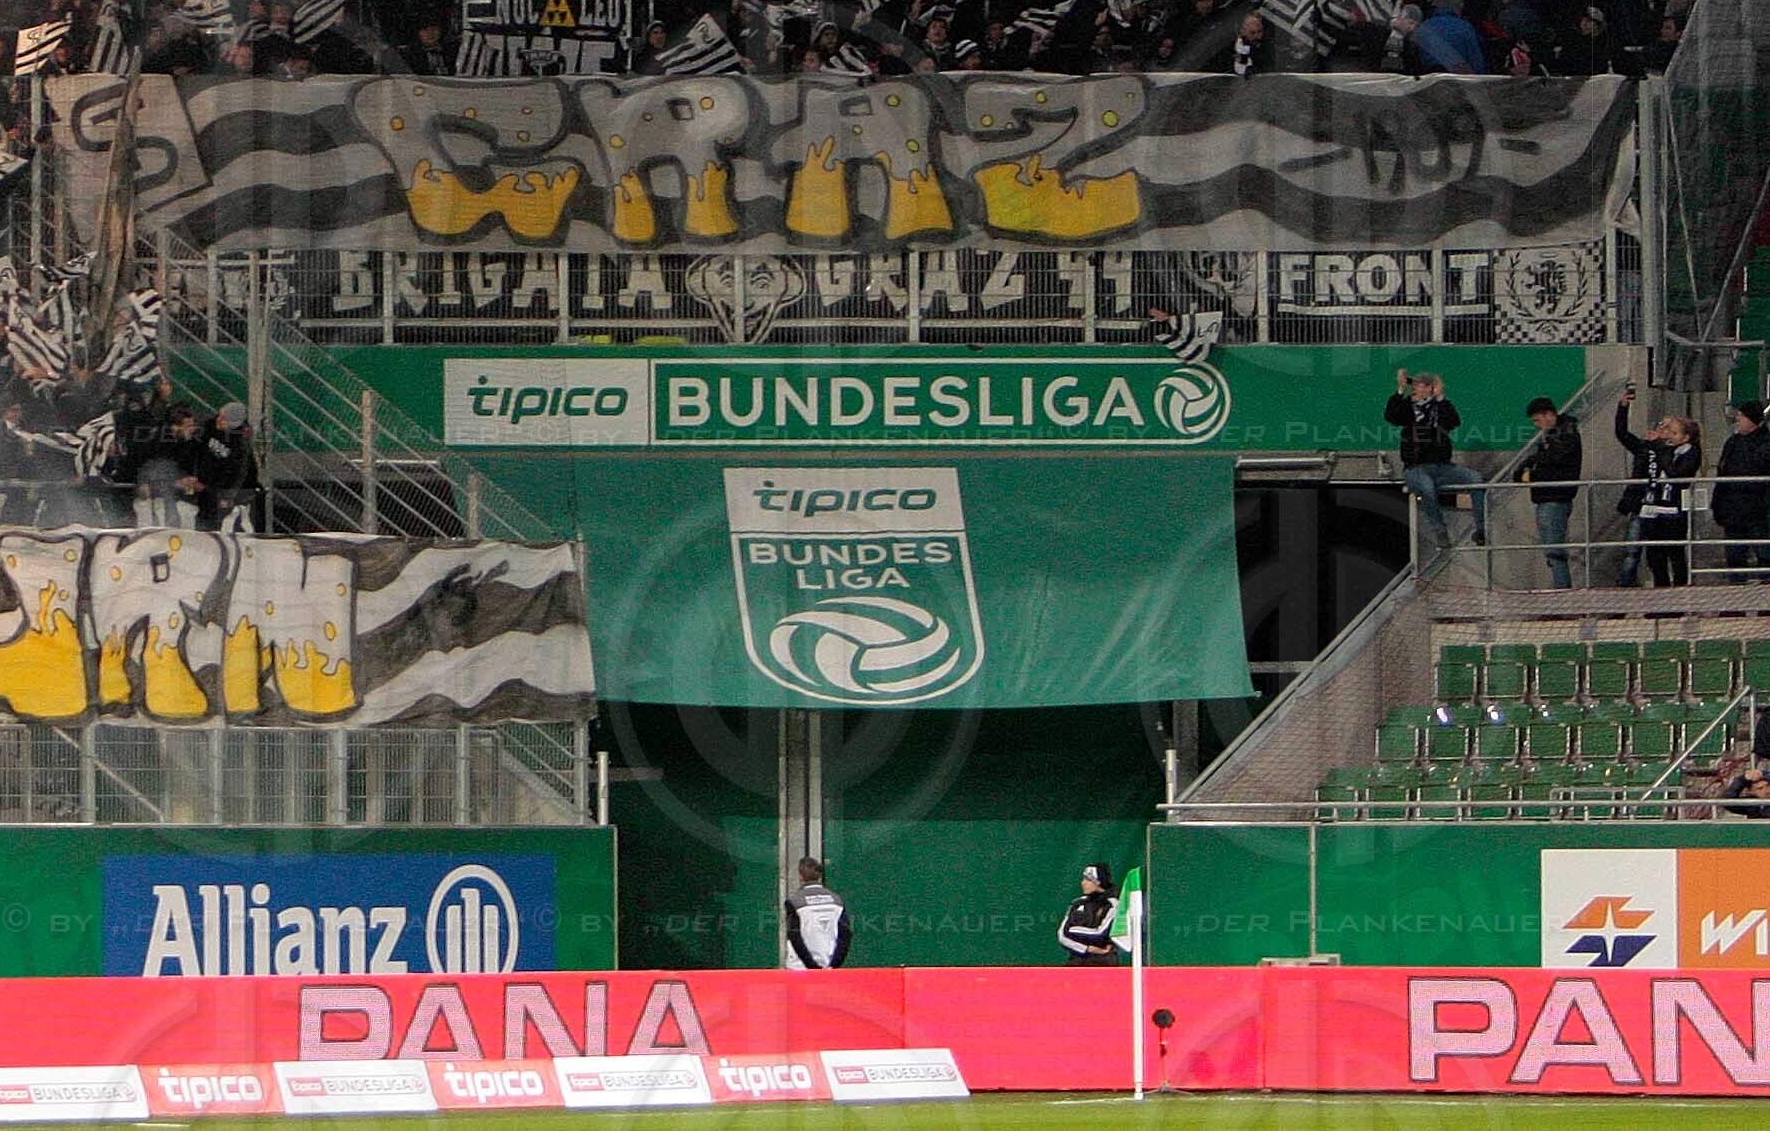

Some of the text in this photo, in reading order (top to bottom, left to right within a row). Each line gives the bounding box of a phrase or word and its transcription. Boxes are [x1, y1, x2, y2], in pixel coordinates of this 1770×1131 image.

[1279, 253, 1490, 303] FRONT
[466, 375, 1145, 427] tipico BUNDESLIGA
[752, 480, 937, 518] tipico
[748, 542, 953, 566] BUNDES
[797, 567, 912, 590] LIGA
[143, 882, 408, 977] Allianz
[298, 979, 714, 1062] PANA
[1408, 976, 1770, 1086] PAN
[158, 1066, 263, 1110] tipico
[444, 1063, 544, 1104] tipico
[718, 1056, 812, 1098] tipico
